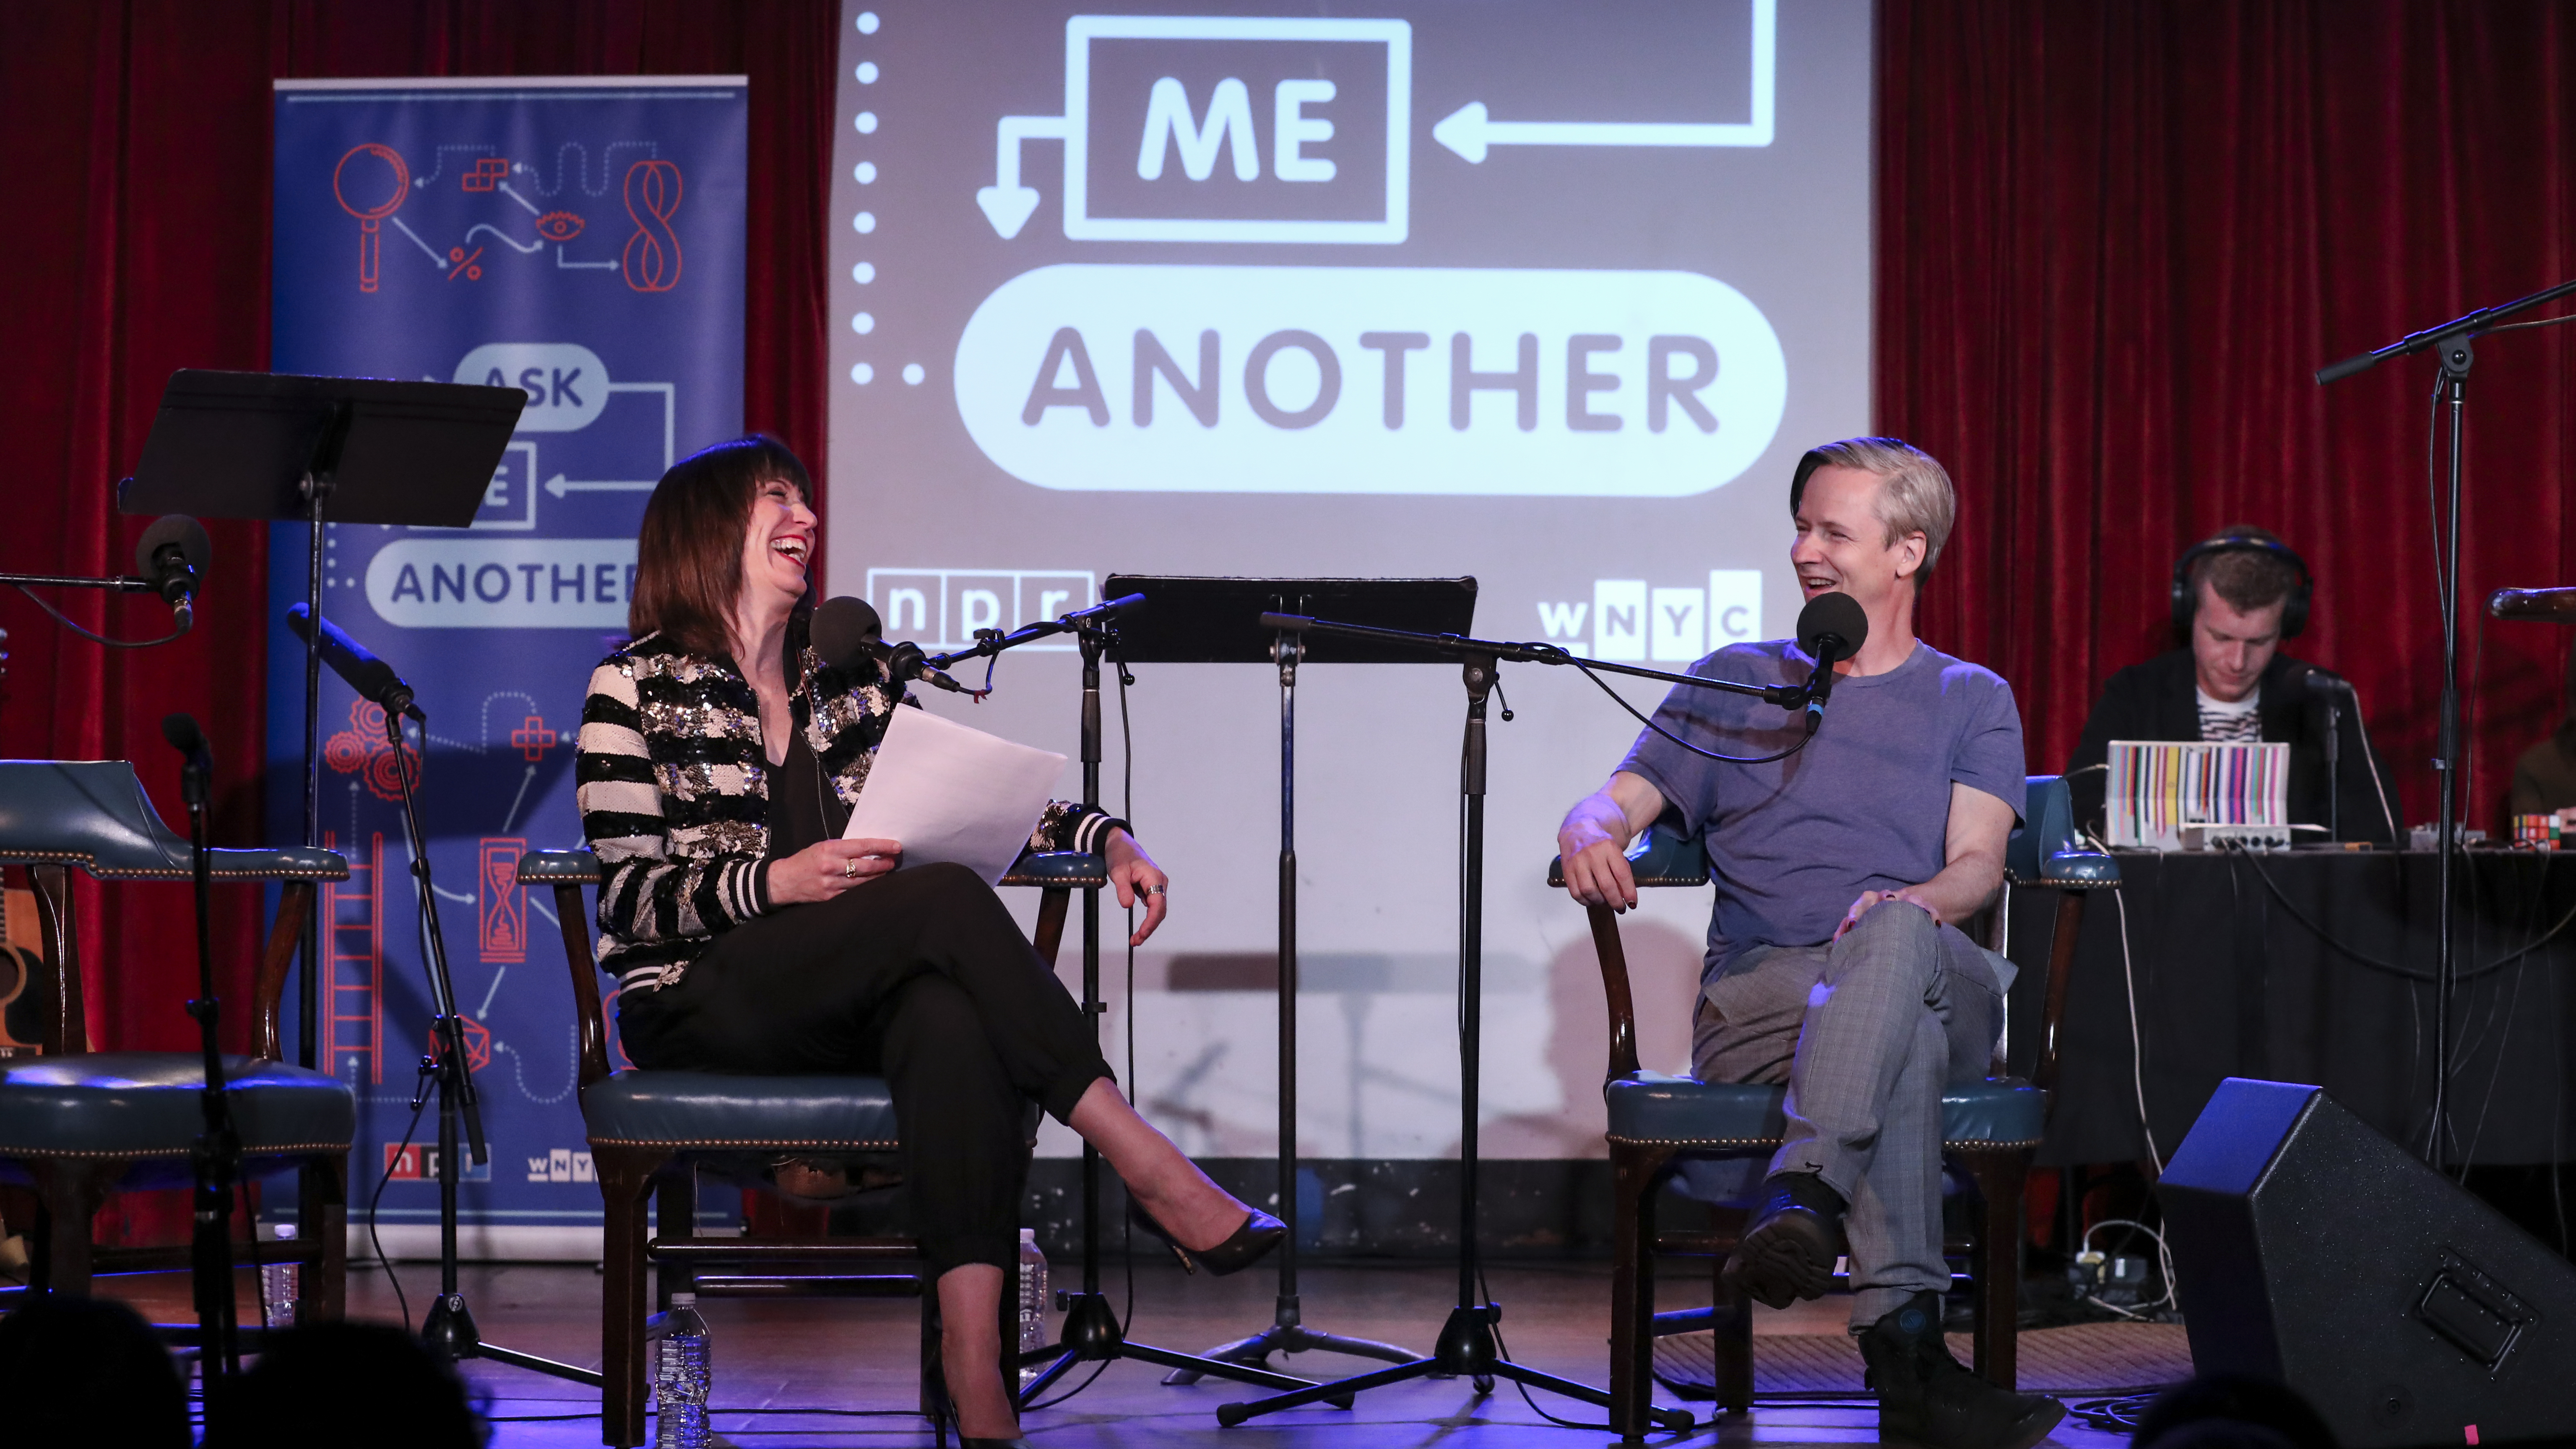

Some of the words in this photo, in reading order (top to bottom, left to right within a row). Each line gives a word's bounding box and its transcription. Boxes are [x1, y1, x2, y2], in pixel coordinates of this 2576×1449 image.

[1137, 77, 1337, 182] ME
[1021, 326, 1720, 434] ANOTHER
[391, 563, 637, 603] ANOTHE
[888, 588, 1069, 641] npr
[1537, 602, 1750, 638] WNYC
[528, 1158, 588, 1173] WNY
